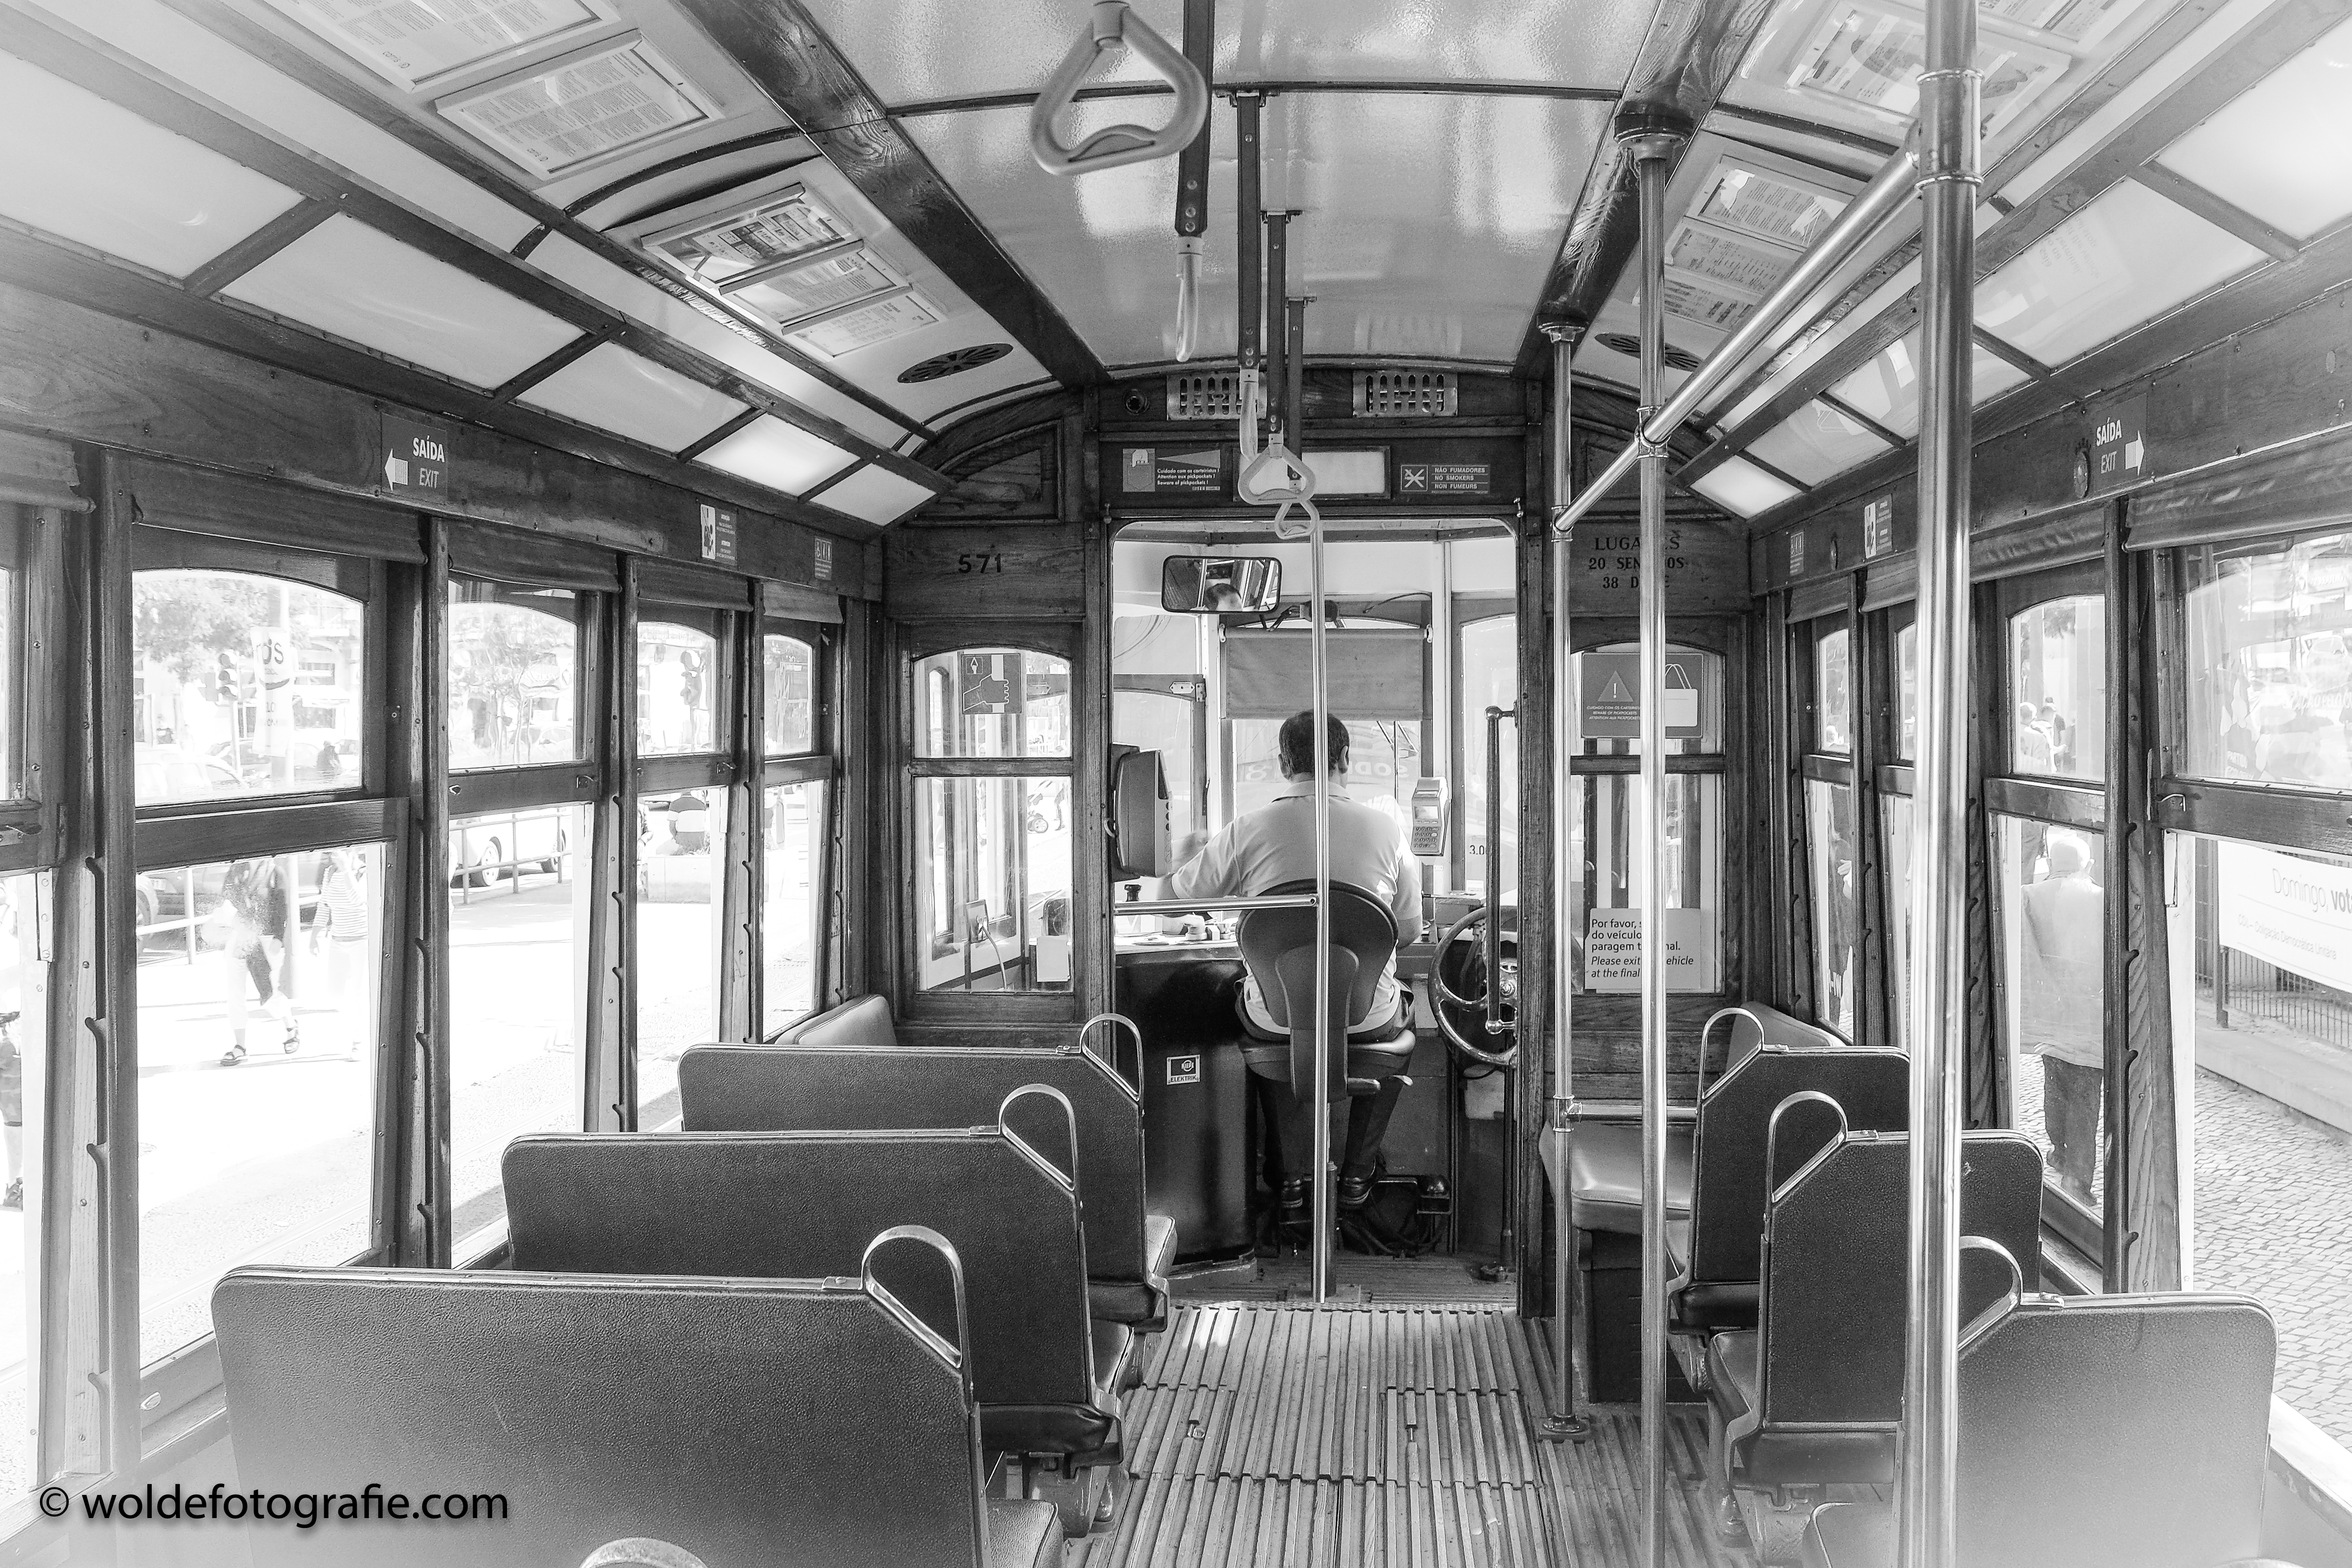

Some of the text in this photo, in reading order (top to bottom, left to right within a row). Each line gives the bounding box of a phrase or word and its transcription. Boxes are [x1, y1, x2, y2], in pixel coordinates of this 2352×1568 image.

[2096, 417, 2122, 447] SAÍDA
[413, 435, 445, 463] SAÍDA
[2100, 451, 2117, 474] EXIT
[419, 468, 440, 489] EXIT
[1594, 537, 1680, 550] LUGAS
[958, 553, 1002, 573] 571
[1588, 556, 1684, 569] 20 SENOS
[1603, 576, 1618, 588] 38
[2272, 868, 2352, 914] Domingo, vot
[1592, 919, 1608, 928] Por
[1610, 918, 1637, 929] favor,
[1592, 930, 1642, 939] do veículo
[1592, 944, 1634, 953] paragem
[1591, 956, 1694, 965] Please exit ehicle
[1591, 968, 1641, 978] at the final
